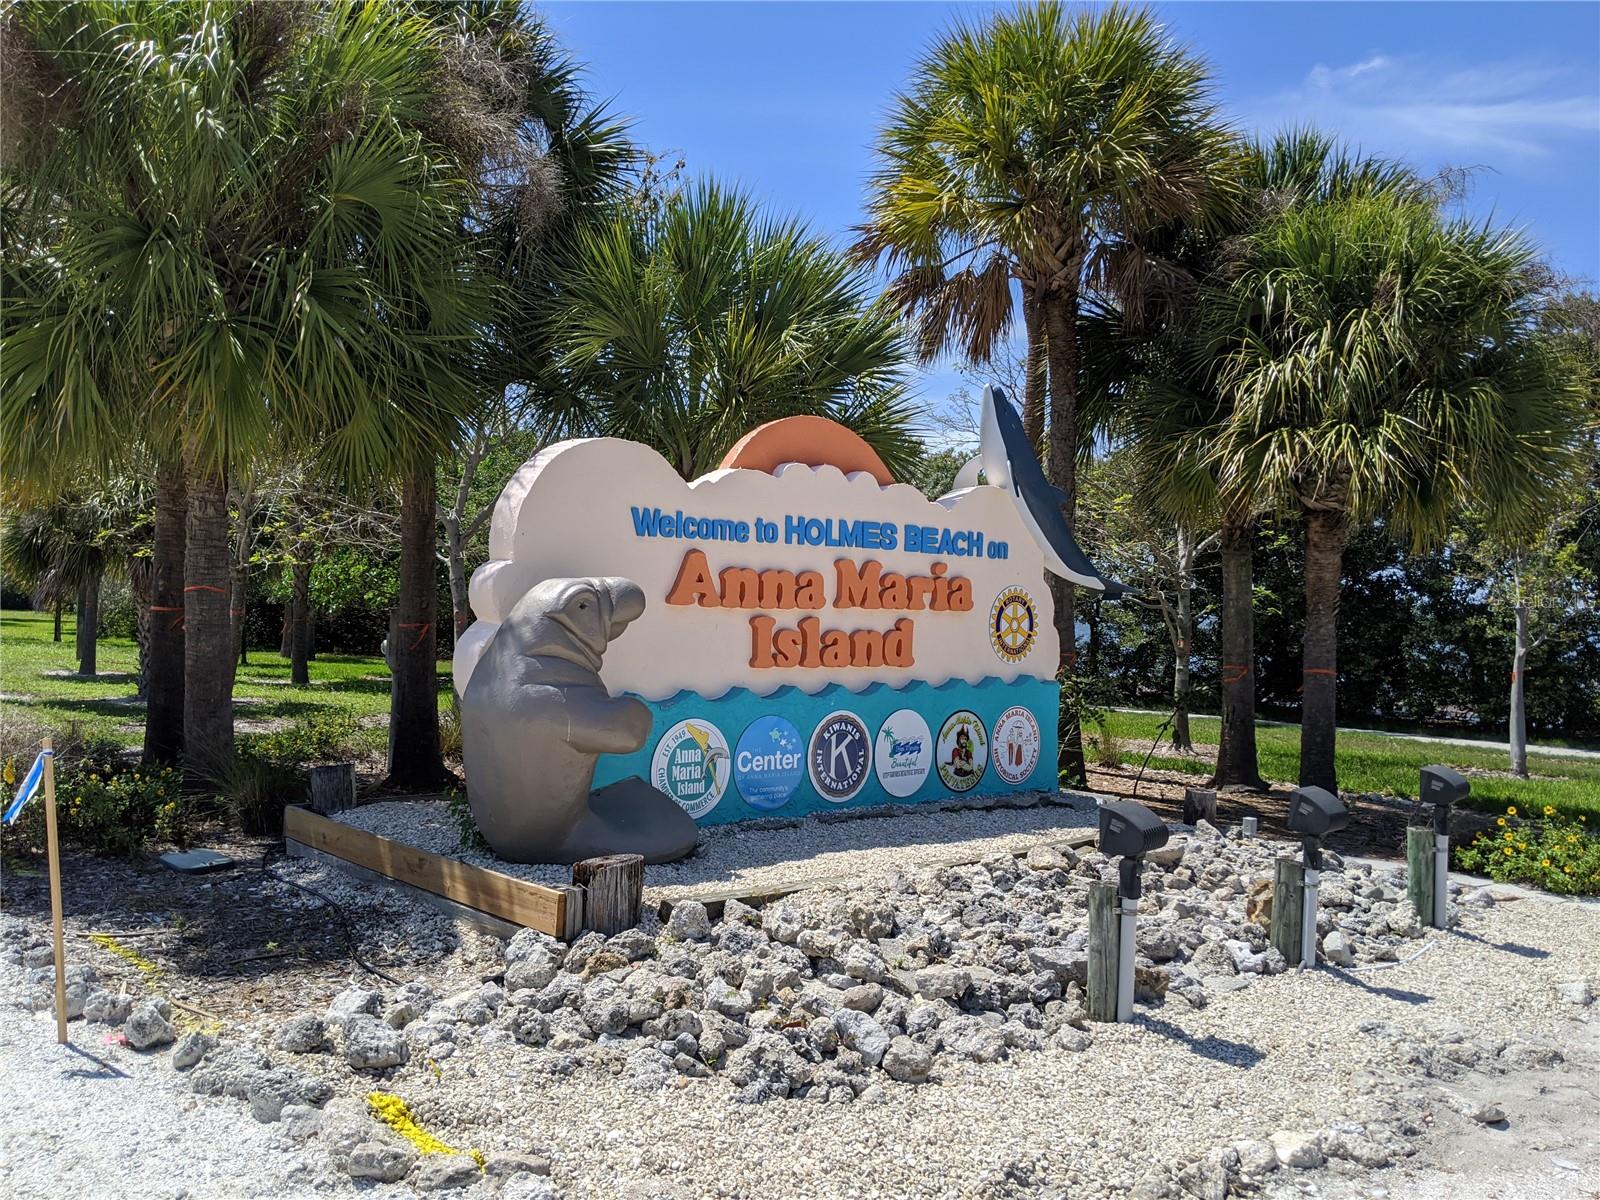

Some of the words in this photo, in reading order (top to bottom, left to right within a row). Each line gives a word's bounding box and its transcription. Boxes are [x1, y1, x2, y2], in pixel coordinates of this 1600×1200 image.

[631, 506, 750, 543] Welcome
[755, 517, 779, 543] to
[785, 515, 898, 550] HOLMES
[904, 524, 984, 557] BEACH
[987, 540, 1008, 559] on
[665, 548, 826, 609] Anna
[833, 558, 974, 611] Maria
[749, 616, 915, 668] Island
[823, 722, 860, 740] KIWANIS
[995, 719, 1006, 741] ANNA
[1005, 709, 1025, 719] MARIA
[1025, 714, 1038, 742] ISLAND
[663, 744, 674, 757] EST.
[671, 730, 686, 744] 1949
[674, 748, 702, 764] Anna
[829, 733, 853, 780] K
[672, 764, 701, 781] Maria
[737, 750, 801, 773] Center
[817, 749, 864, 790] INTERNATIONAL
[994, 748, 1019, 779] HISTORICAL
[1020, 748, 1037, 777] SOCIETY
[677, 780, 705, 796] Island
[681, 792, 715, 812] COMMERCE
